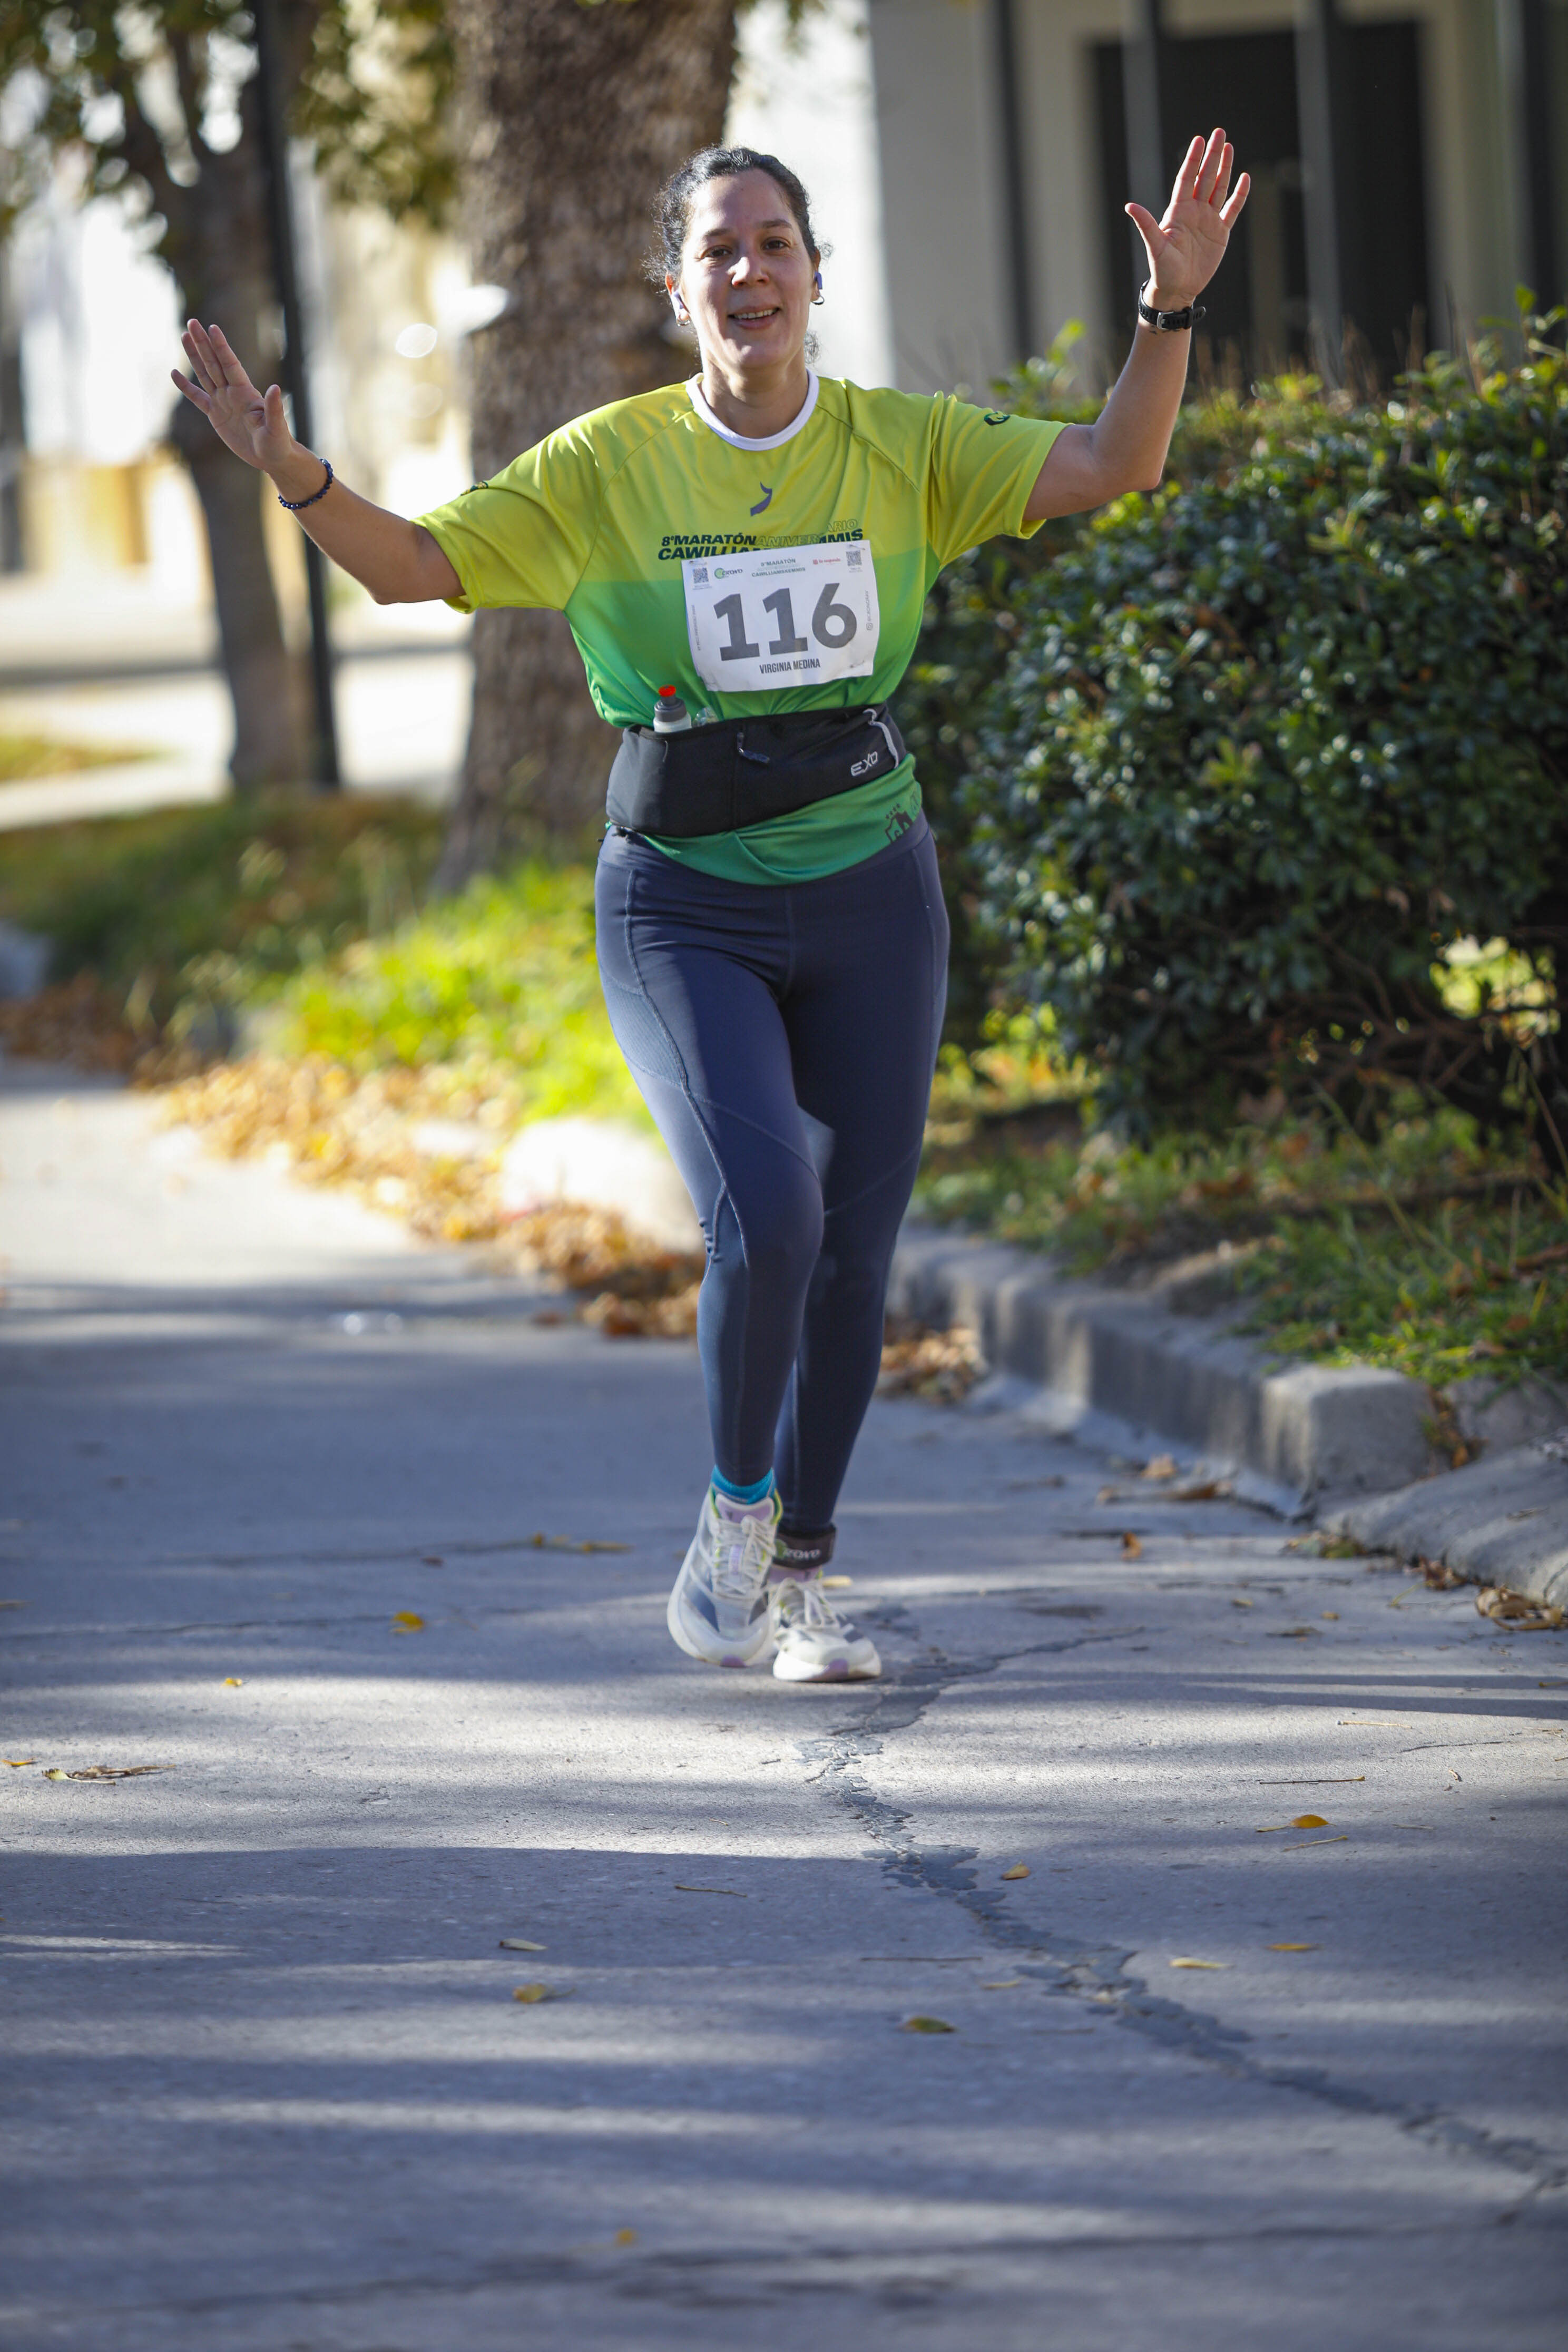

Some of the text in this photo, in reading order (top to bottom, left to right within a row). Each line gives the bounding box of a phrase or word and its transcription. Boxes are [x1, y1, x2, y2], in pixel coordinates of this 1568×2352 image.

[713, 583, 857, 661] 116
[759, 658, 821, 674] VIRGINIA MEDINA
